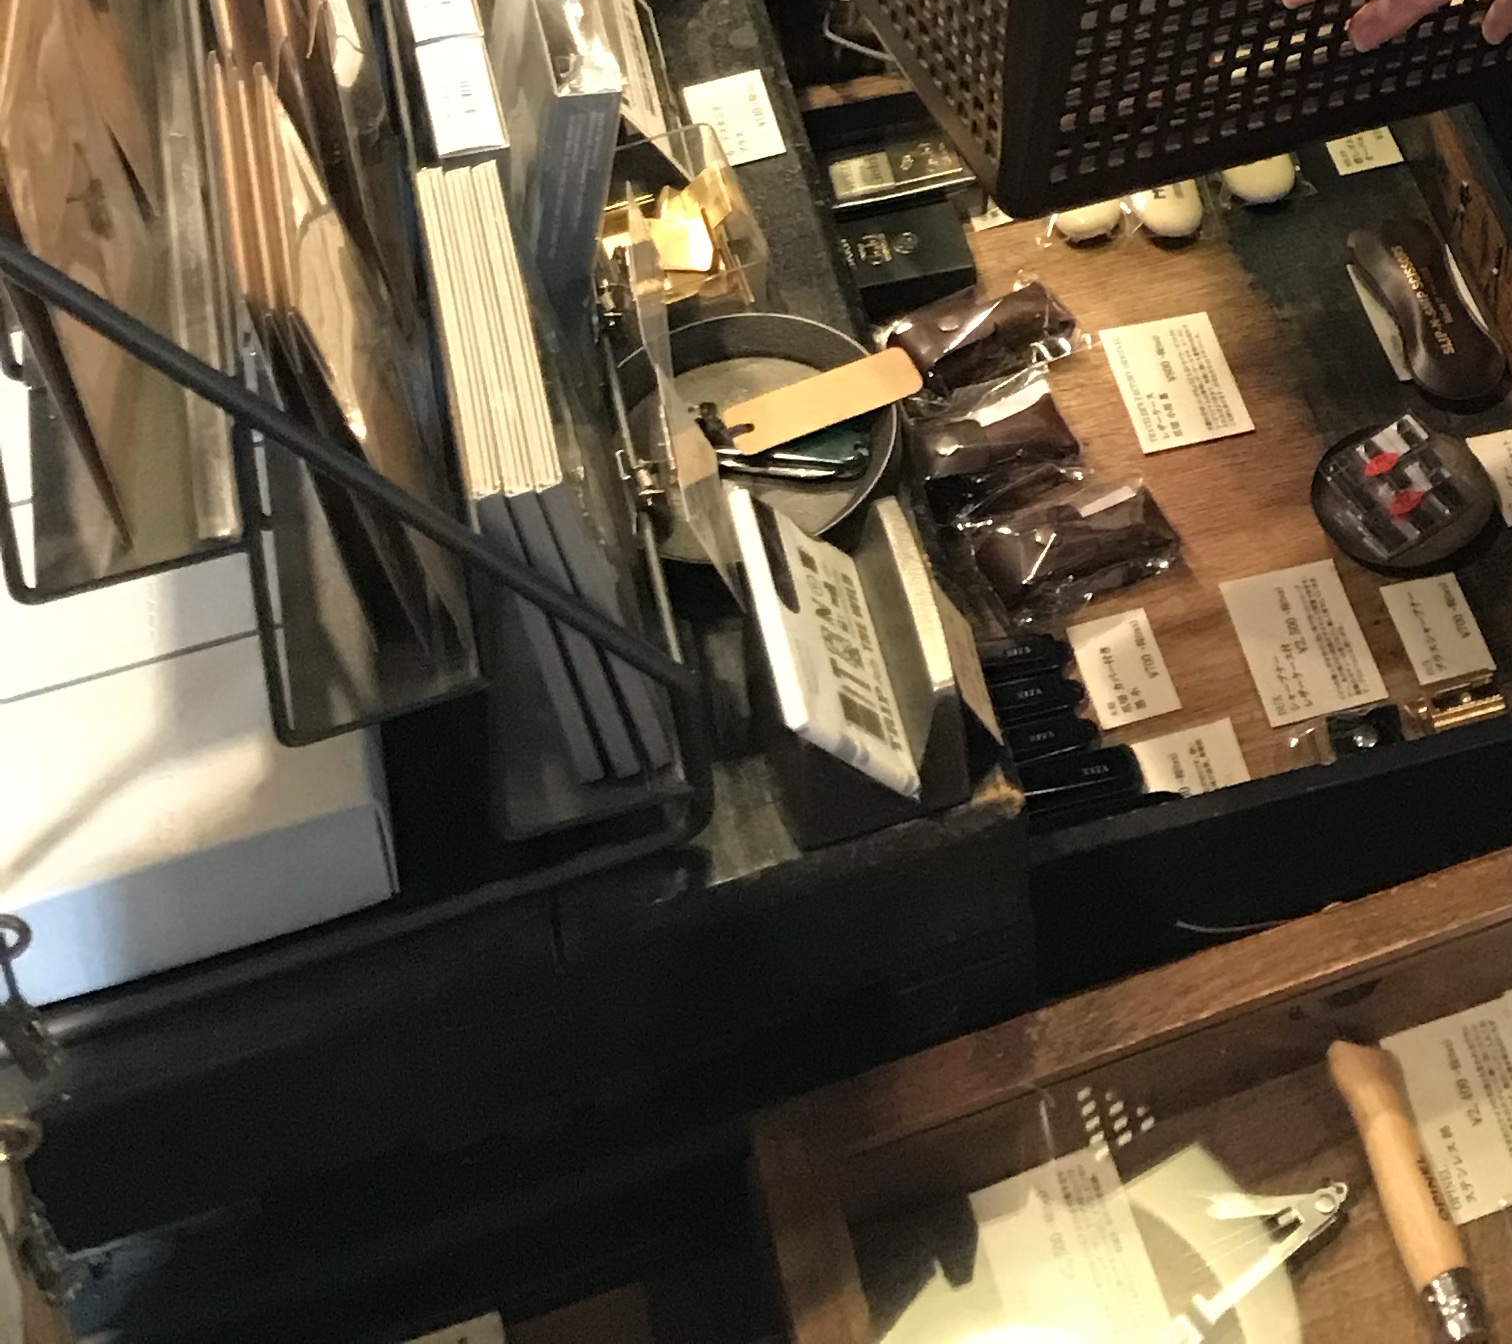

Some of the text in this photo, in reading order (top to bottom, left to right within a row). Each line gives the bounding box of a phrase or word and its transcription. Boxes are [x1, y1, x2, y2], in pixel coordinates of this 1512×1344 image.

[1390, 243, 1425, 292] SCISSORS
[1112, 336, 1130, 369] ORIGINAL
[1124, 369, 1143, 401] FACTORY
[1145, 391, 1170, 439] レザーケース
[840, 571, 863, 619] WILD
[854, 620, 873, 653] THE
[1140, 652, 1159, 679] ¥700
[1270, 655, 1300, 712] シャープナー
[874, 684, 903, 754] TRIP
[1270, 694, 1287, 716] DUX
[1414, 1156, 1452, 1223] OPINEL
[1435, 1163, 1463, 1211] OPINEL
[1444, 1141, 1478, 1203] ステンレス
